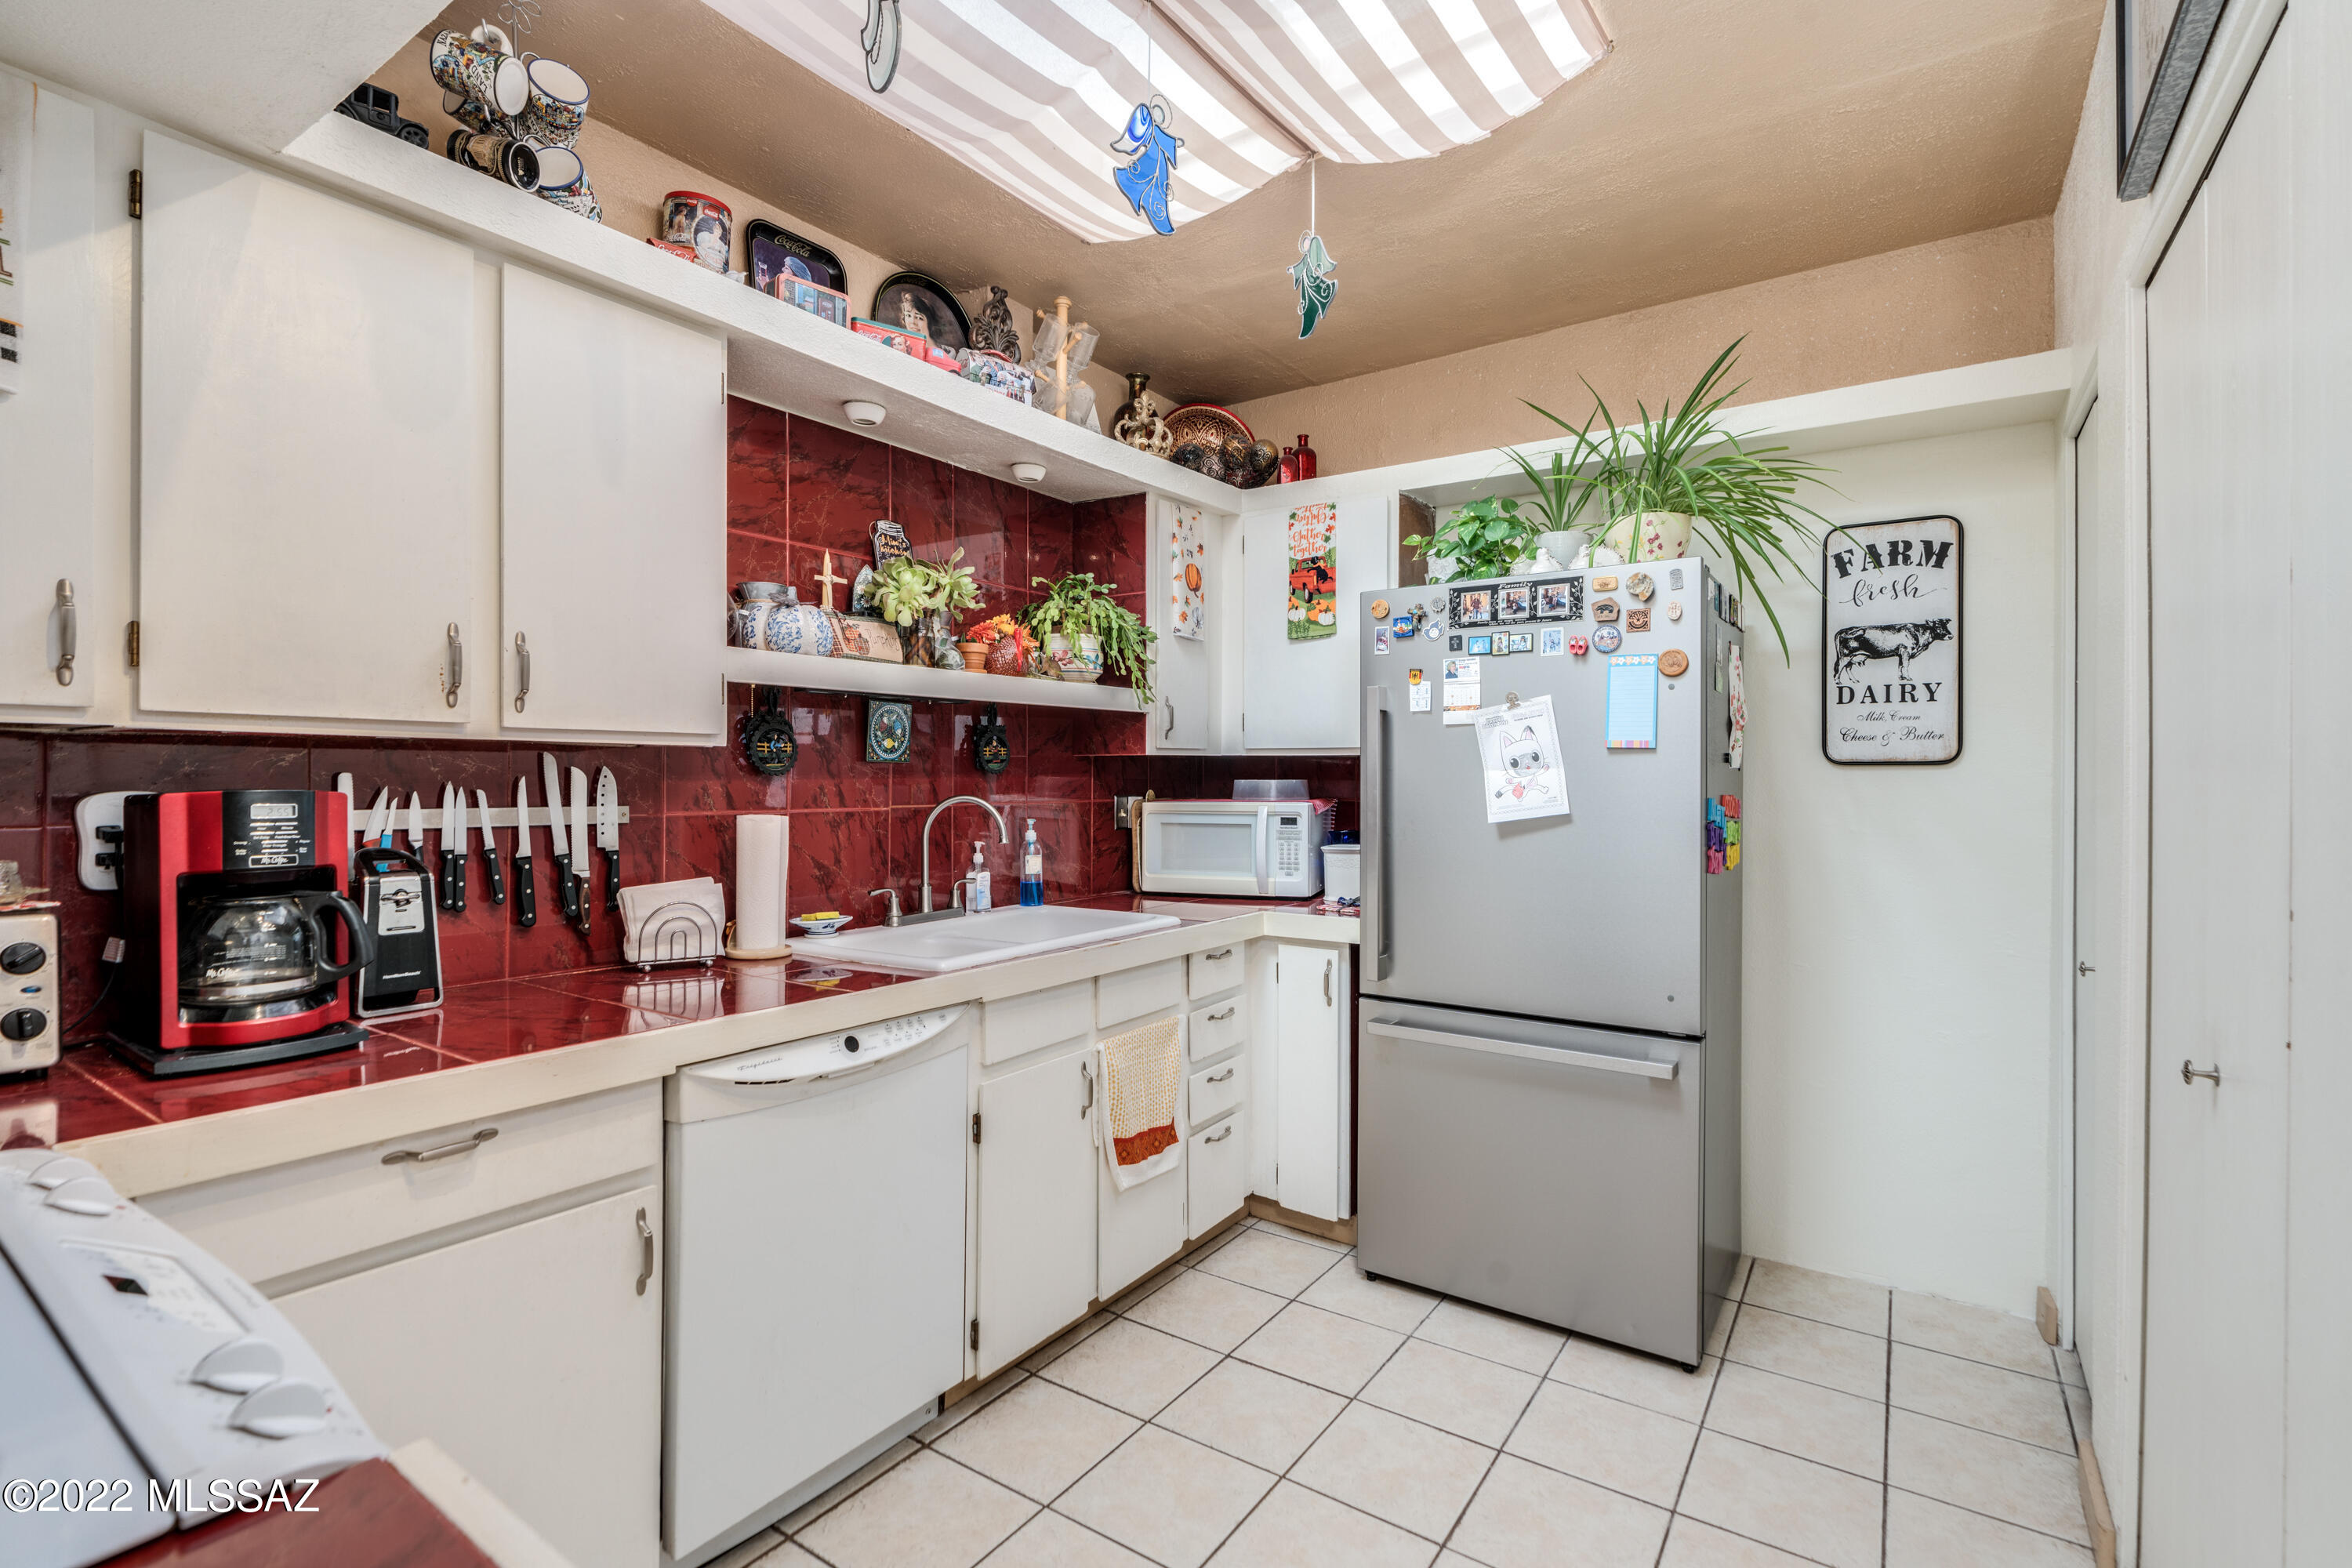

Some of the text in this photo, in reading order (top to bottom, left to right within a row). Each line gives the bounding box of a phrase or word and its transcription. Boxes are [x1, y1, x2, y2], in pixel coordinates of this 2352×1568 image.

[1292, 528, 1324, 547] Gather
[1292, 541, 1327, 558] together
[1831, 539, 1954, 579] FARM
[1498, 581, 1534, 590] Family
[1838, 573, 1947, 608] fresh
[1836, 682, 1943, 705] DAIRY
[1857, 710, 1921, 723] Milk, Cream
[1839, 724, 1944, 746] Cheese & Butter
